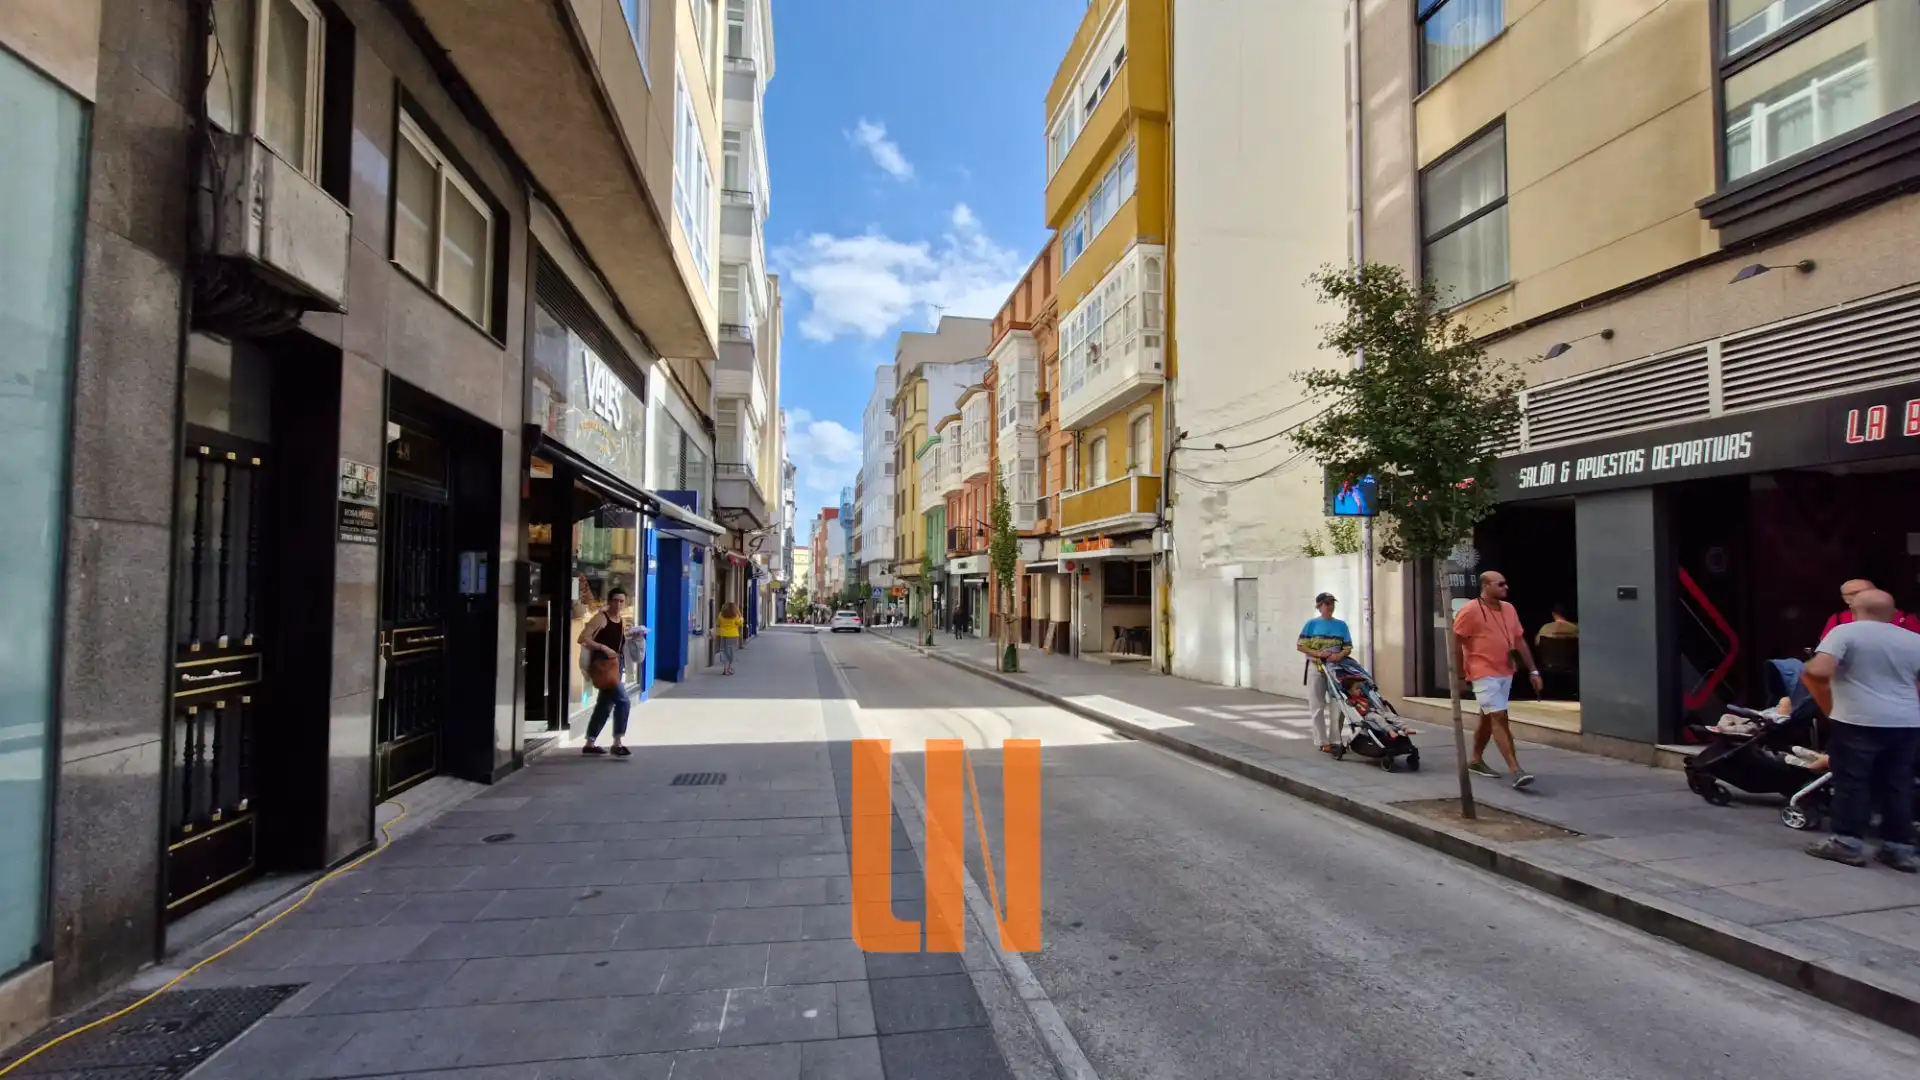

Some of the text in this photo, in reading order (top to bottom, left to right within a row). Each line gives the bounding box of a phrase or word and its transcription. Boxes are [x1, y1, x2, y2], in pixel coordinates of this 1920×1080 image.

[1847, 405, 1887, 444] LA
[1519, 461, 1556, 488] SALÓN
[1560, 461, 1570, 483] &
[1576, 449, 1645, 480] APUESTAS
